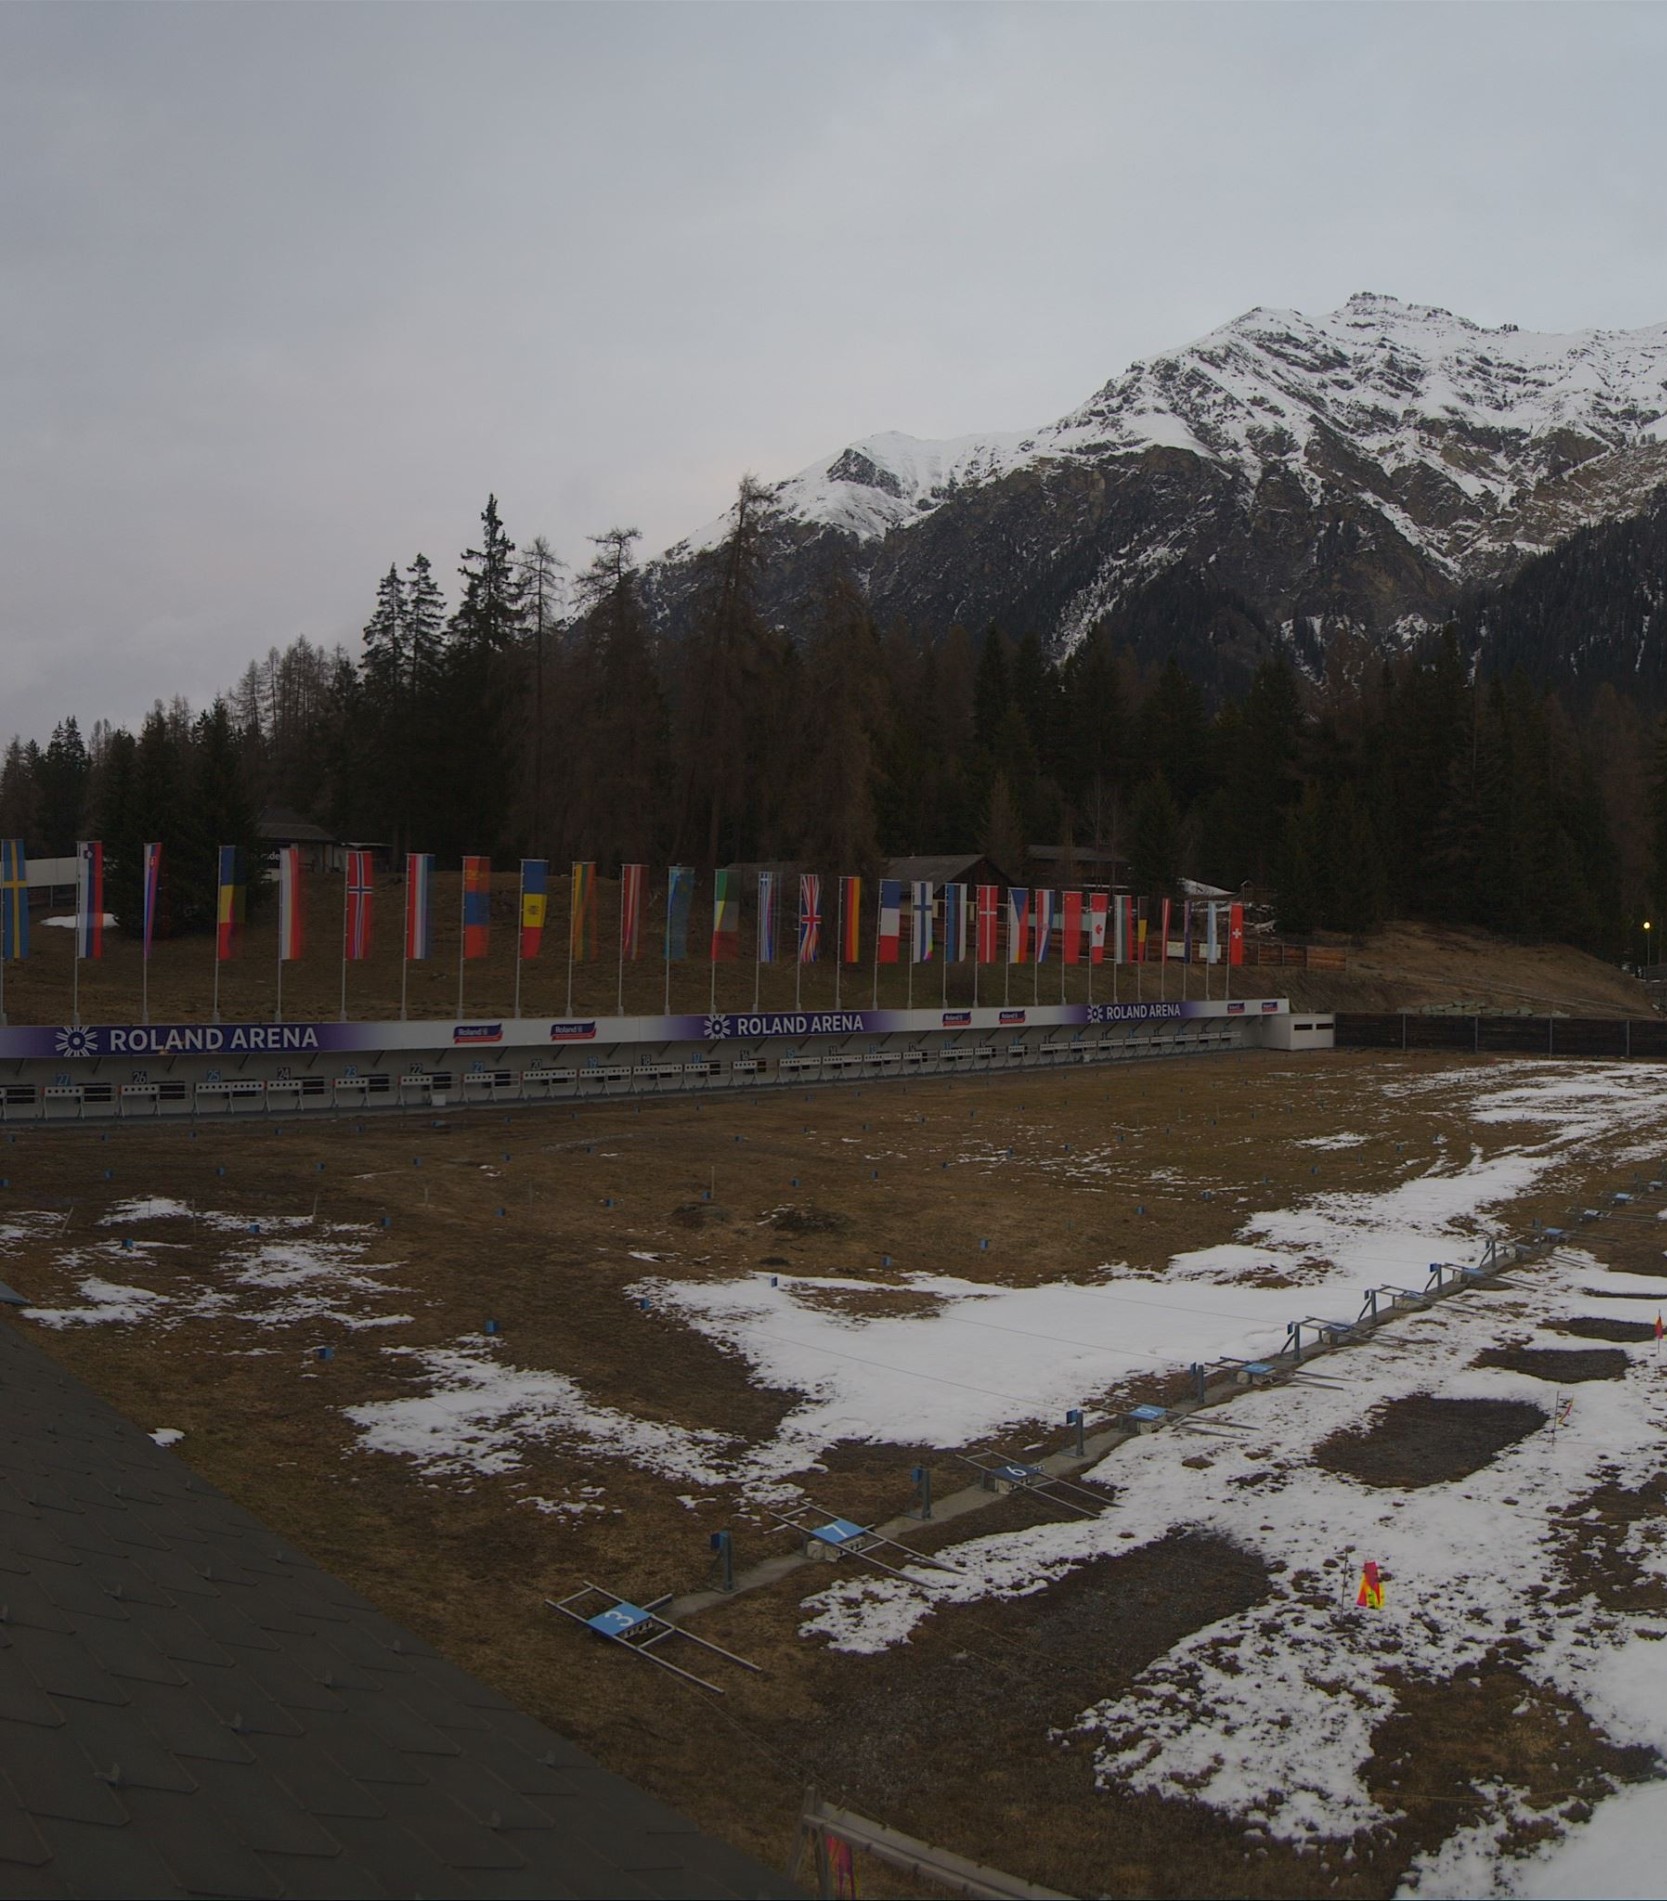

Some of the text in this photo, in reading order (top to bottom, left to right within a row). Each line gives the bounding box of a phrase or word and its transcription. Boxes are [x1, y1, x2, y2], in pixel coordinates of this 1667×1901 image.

[1106, 1003, 1180, 1020] ROLAND ARENA
[737, 1014, 864, 1036] ROLAND ARENA
[110, 1027, 319, 1051] ROLAND ARENA
[207, 1070, 220, 1081] 25
[278, 1068, 290, 1079] 24
[345, 1066, 357, 1077] 23
[57, 1074, 70, 1085] 27
[133, 1072, 147, 1083] 26
[604, 1610, 634, 1627] 3
